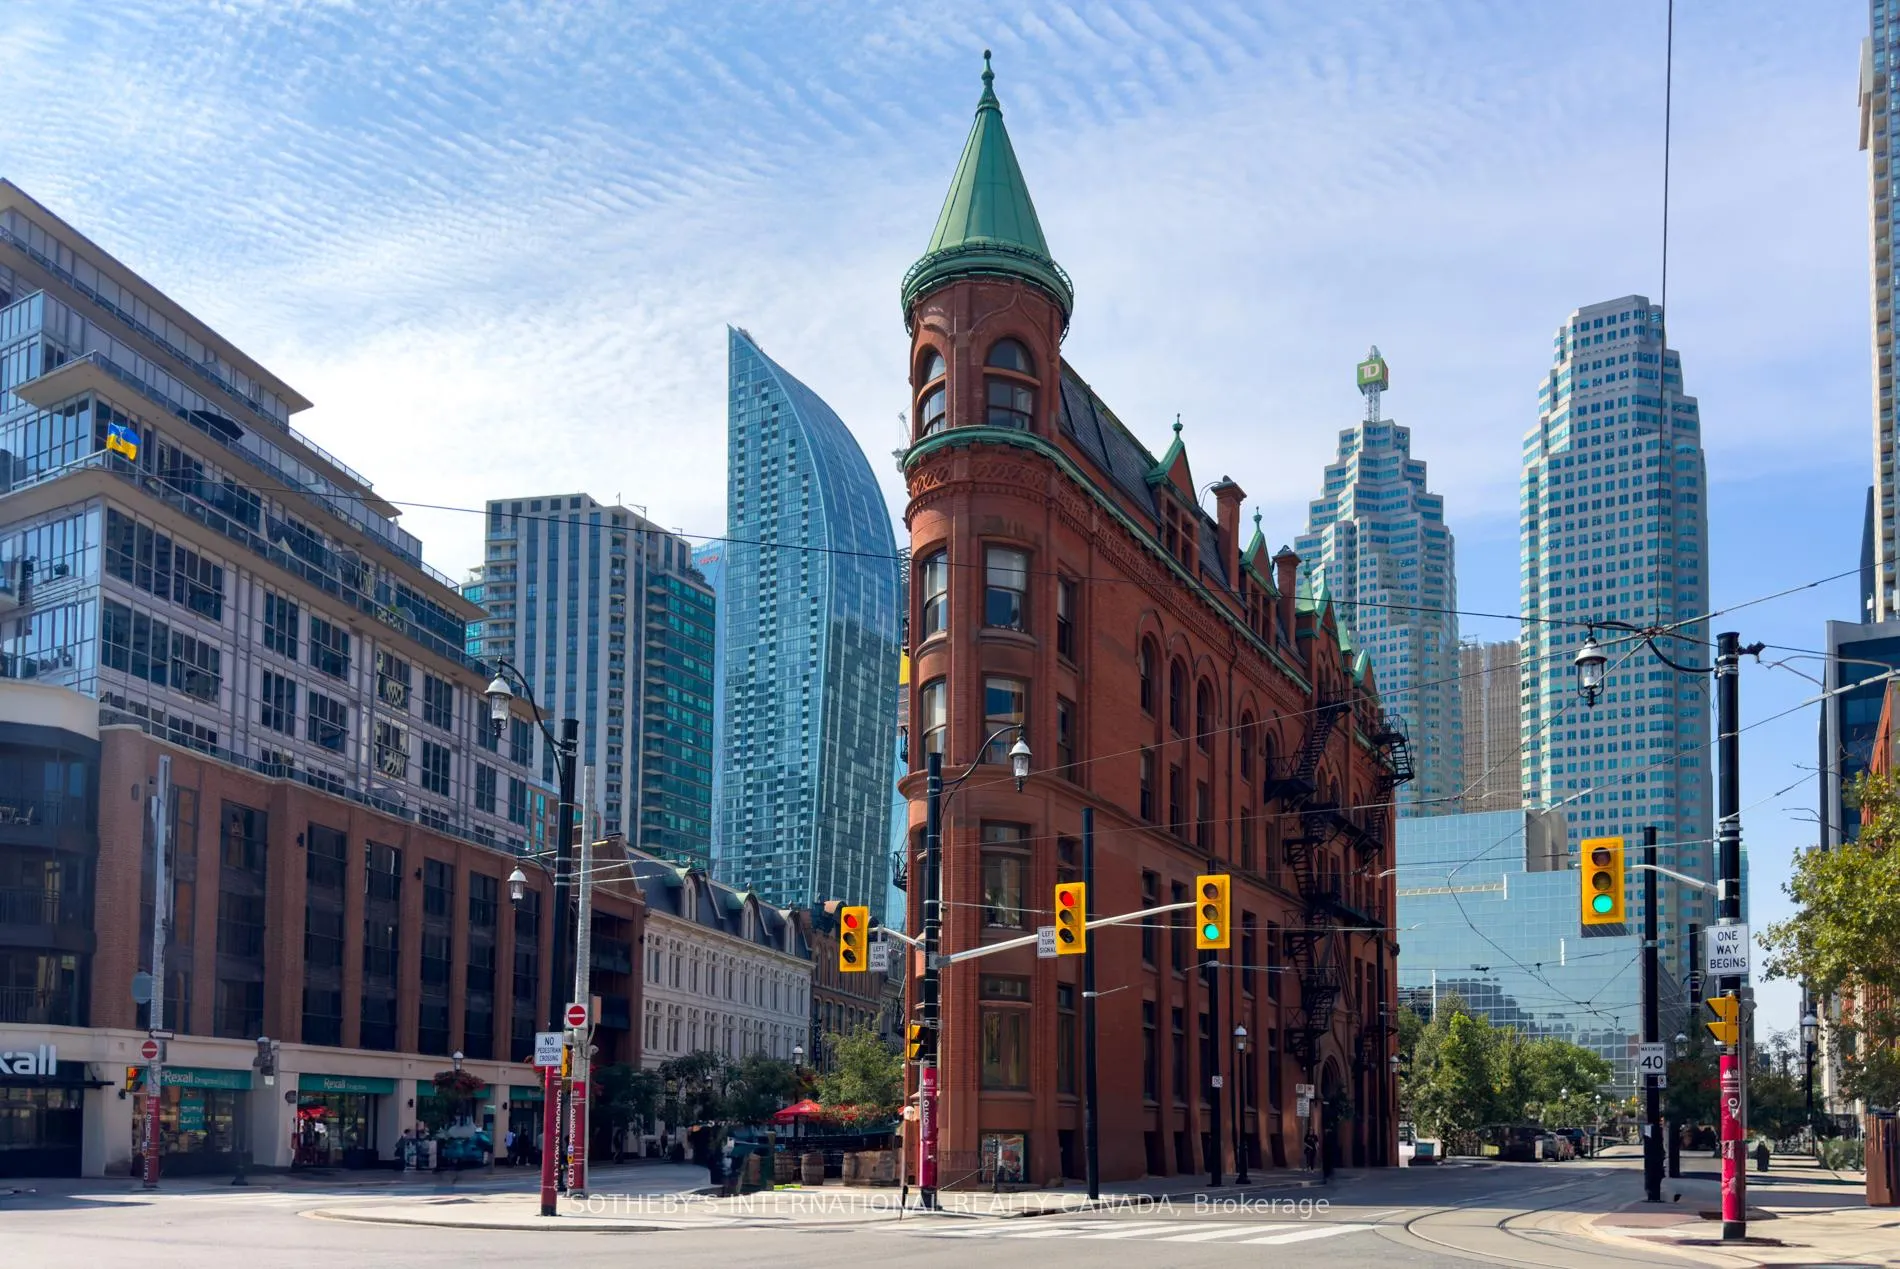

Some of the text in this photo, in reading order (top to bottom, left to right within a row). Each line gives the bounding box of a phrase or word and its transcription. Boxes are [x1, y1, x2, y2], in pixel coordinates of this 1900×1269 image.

[1360, 363, 1380, 379] TD
[1041, 930, 1054, 938] LEFT
[1717, 930, 1739, 941] ONE
[1039, 946, 1057, 954] SIGNAL
[1716, 943, 1740, 955] WAY
[1710, 956, 1747, 969] BEGINS
[544, 1036, 555, 1046] NO
[537, 1046, 562, 1054] PEDESTRIAN
[539, 1054, 559, 1062] CROSSING
[1641, 1055, 1664, 1069] 40
[164, 1069, 194, 1083] Rexall
[324, 1078, 346, 1089] Rexall
[554, 1089, 562, 1134] TORONTO
